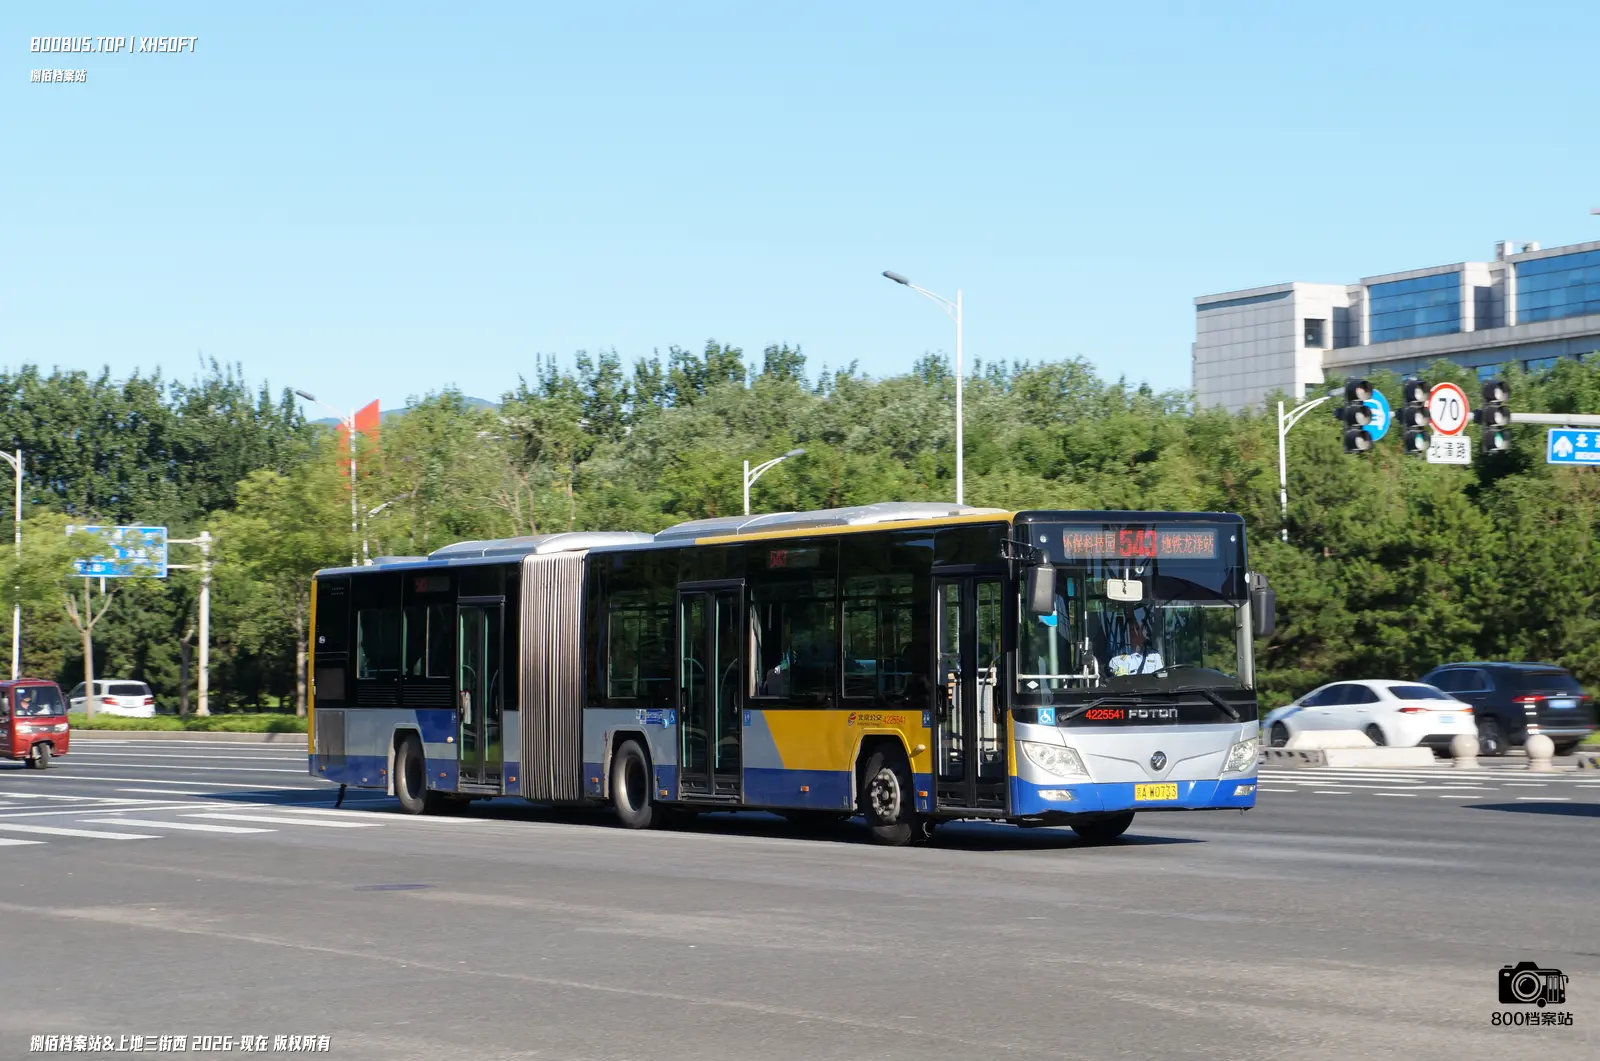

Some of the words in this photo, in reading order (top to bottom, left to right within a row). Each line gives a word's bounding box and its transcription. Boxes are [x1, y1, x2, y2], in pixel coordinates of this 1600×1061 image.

[1438, 397, 1460, 422] 70
[1063, 532, 1116, 553] 环保科技园
[1119, 529, 1157, 557] 543
[1161, 533, 1214, 553] 地铁龙泽站
[858, 713, 882, 721] 北京公交
[883, 715, 906, 725] 4225541
[1085, 709, 1124, 720] 4225541
